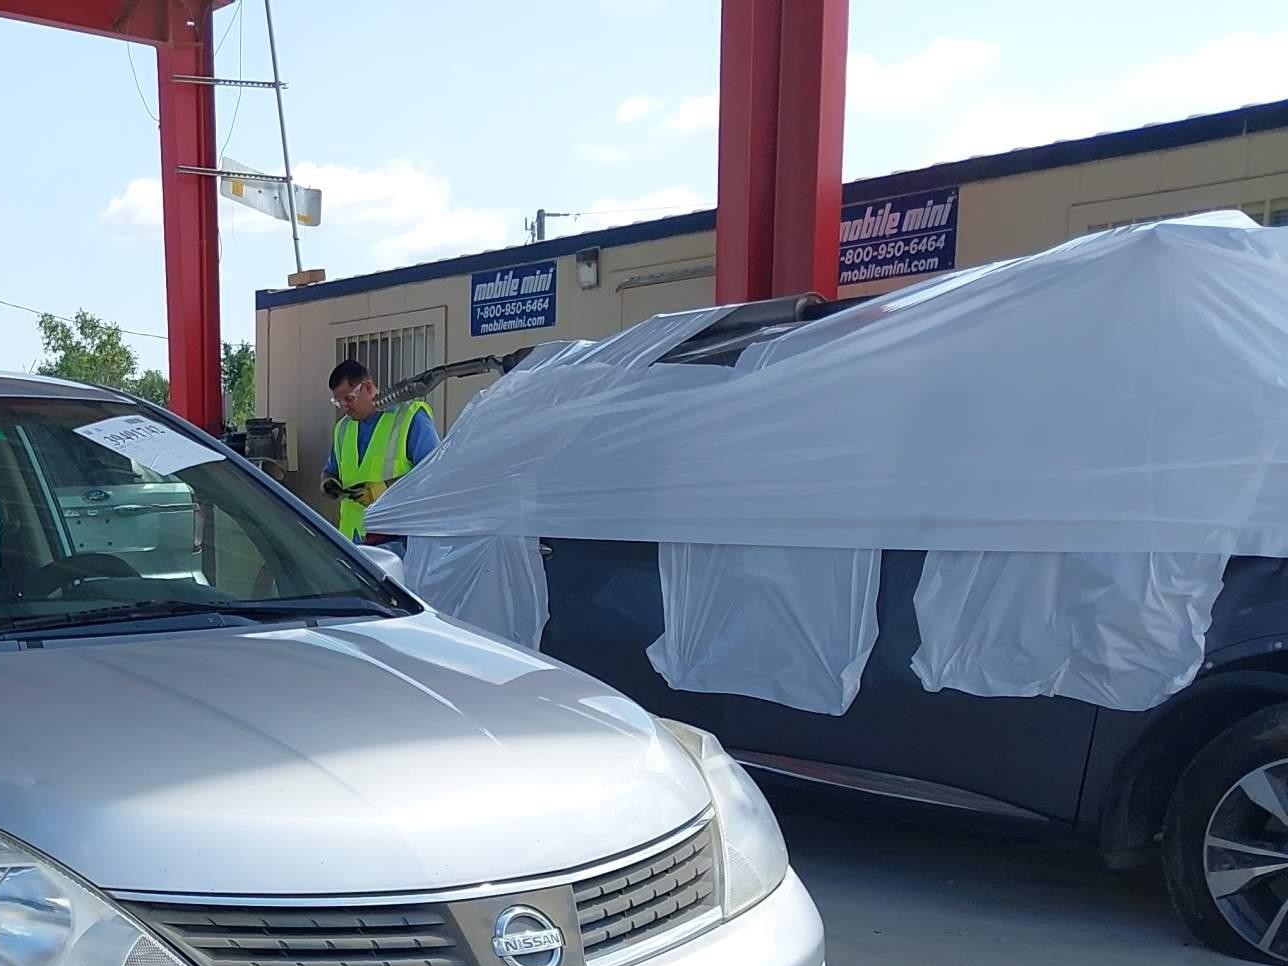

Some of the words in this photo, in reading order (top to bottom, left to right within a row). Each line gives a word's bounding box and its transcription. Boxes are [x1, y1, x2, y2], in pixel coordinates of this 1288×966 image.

[902, 197, 953, 232] mini
[840, 234, 946, 264] -800-950-6464
[840, 257, 939, 282] mobilemini.com
[474, 270, 520, 301] mobile
[520, 268, 553, 295] mini
[476, 297, 550, 320] 1-800-950-6464
[480, 316, 545, 333] mobilemini.com
[103, 424, 166, 446] 39491742
[504, 933, 560, 952] NISSAN
